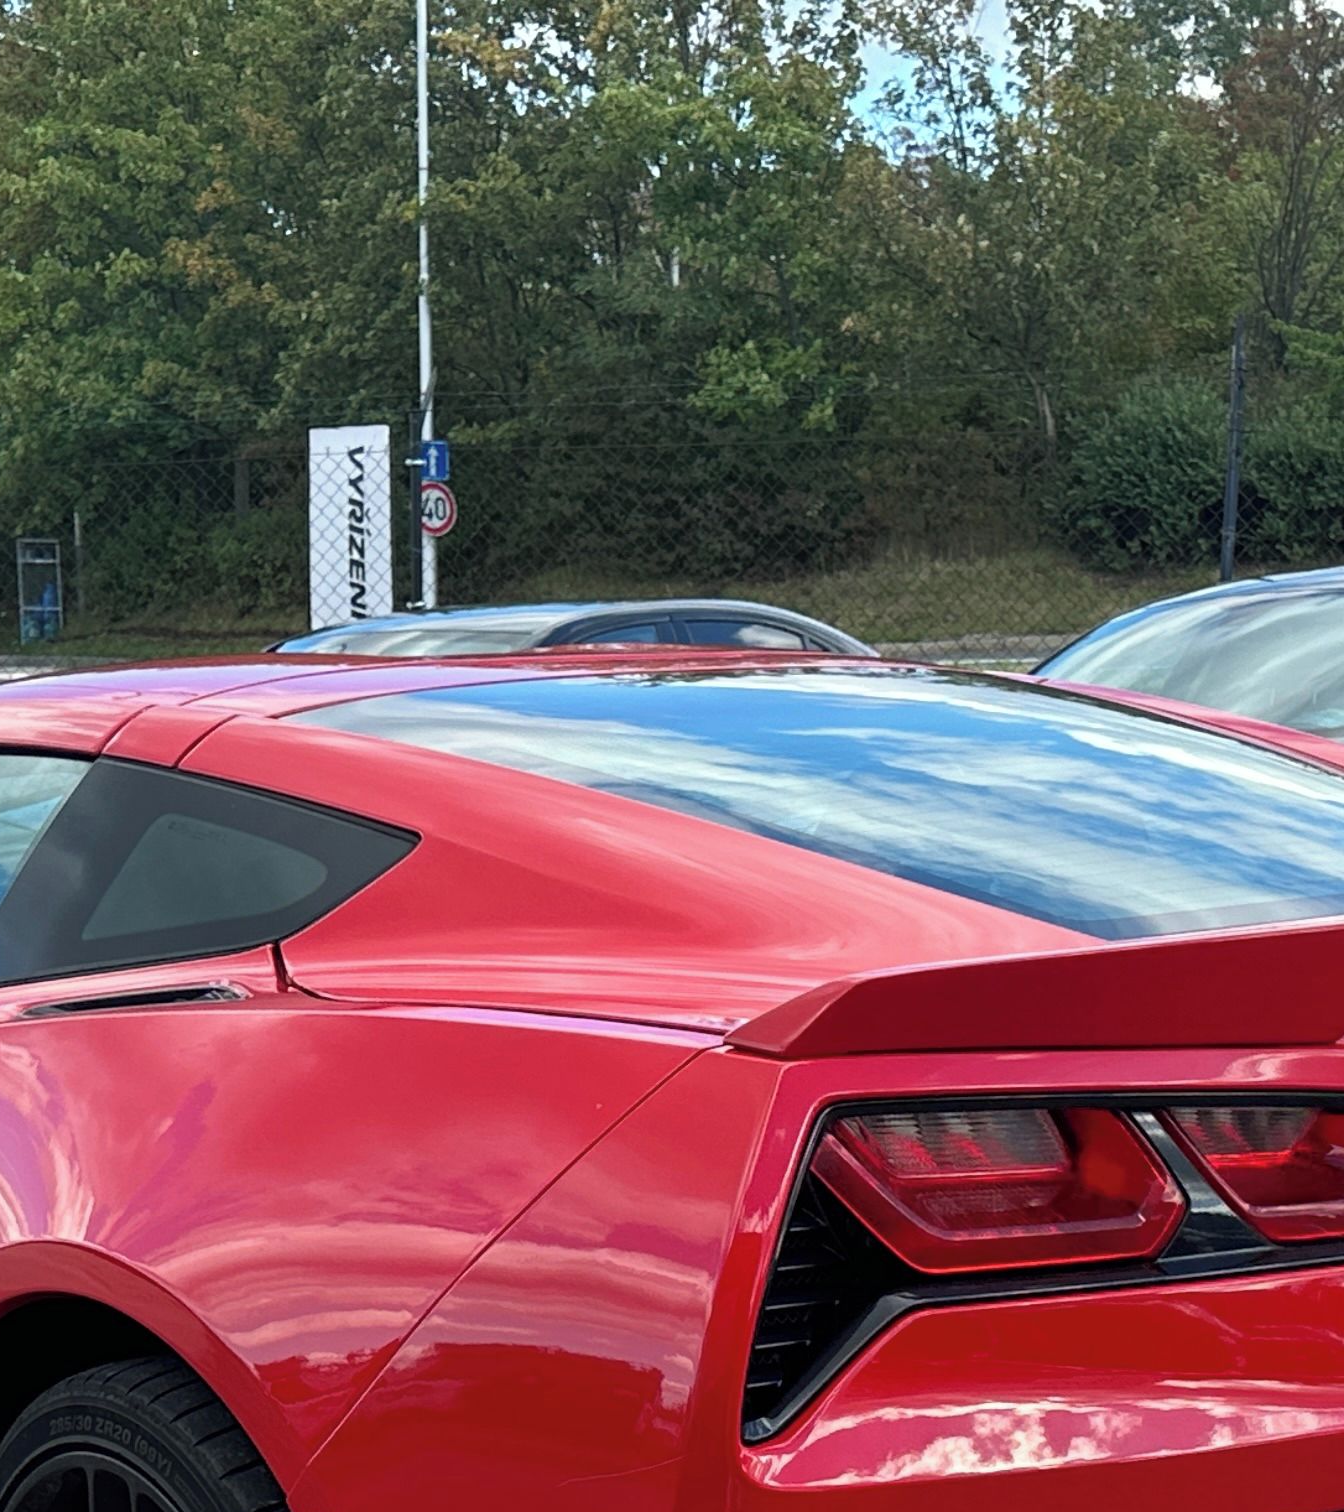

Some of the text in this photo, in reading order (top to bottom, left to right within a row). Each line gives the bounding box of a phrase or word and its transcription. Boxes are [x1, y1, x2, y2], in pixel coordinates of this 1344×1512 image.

[422, 493, 446, 521] 40
[49, 1414, 93, 1437] 285/30
[95, 1418, 132, 1446] ZR20
